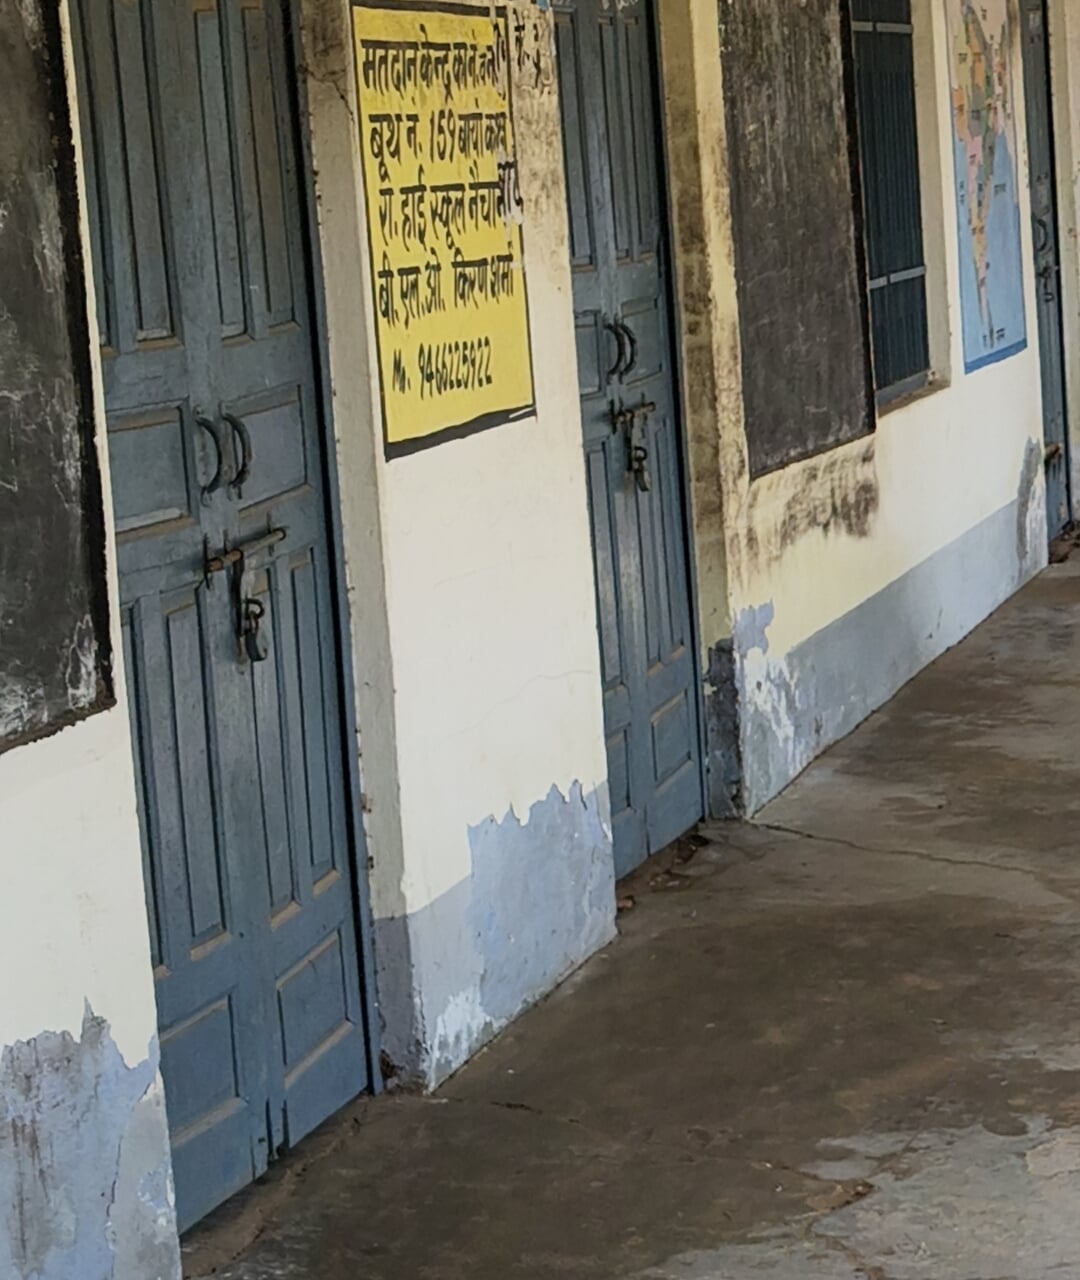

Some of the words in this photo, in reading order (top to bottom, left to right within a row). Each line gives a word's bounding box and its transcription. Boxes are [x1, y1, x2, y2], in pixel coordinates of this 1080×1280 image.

[360, 39, 419, 99] मतदान
[420, 24, 454, 103] केन्द्र
[368, 114, 402, 183] बूथ
[430, 109, 455, 163] 159
[399, 164, 428, 252] हाई
[430, 183, 467, 250] स्कूल
[451, 248, 489, 309] किरण
[418, 336, 493, 401] 9466225922
